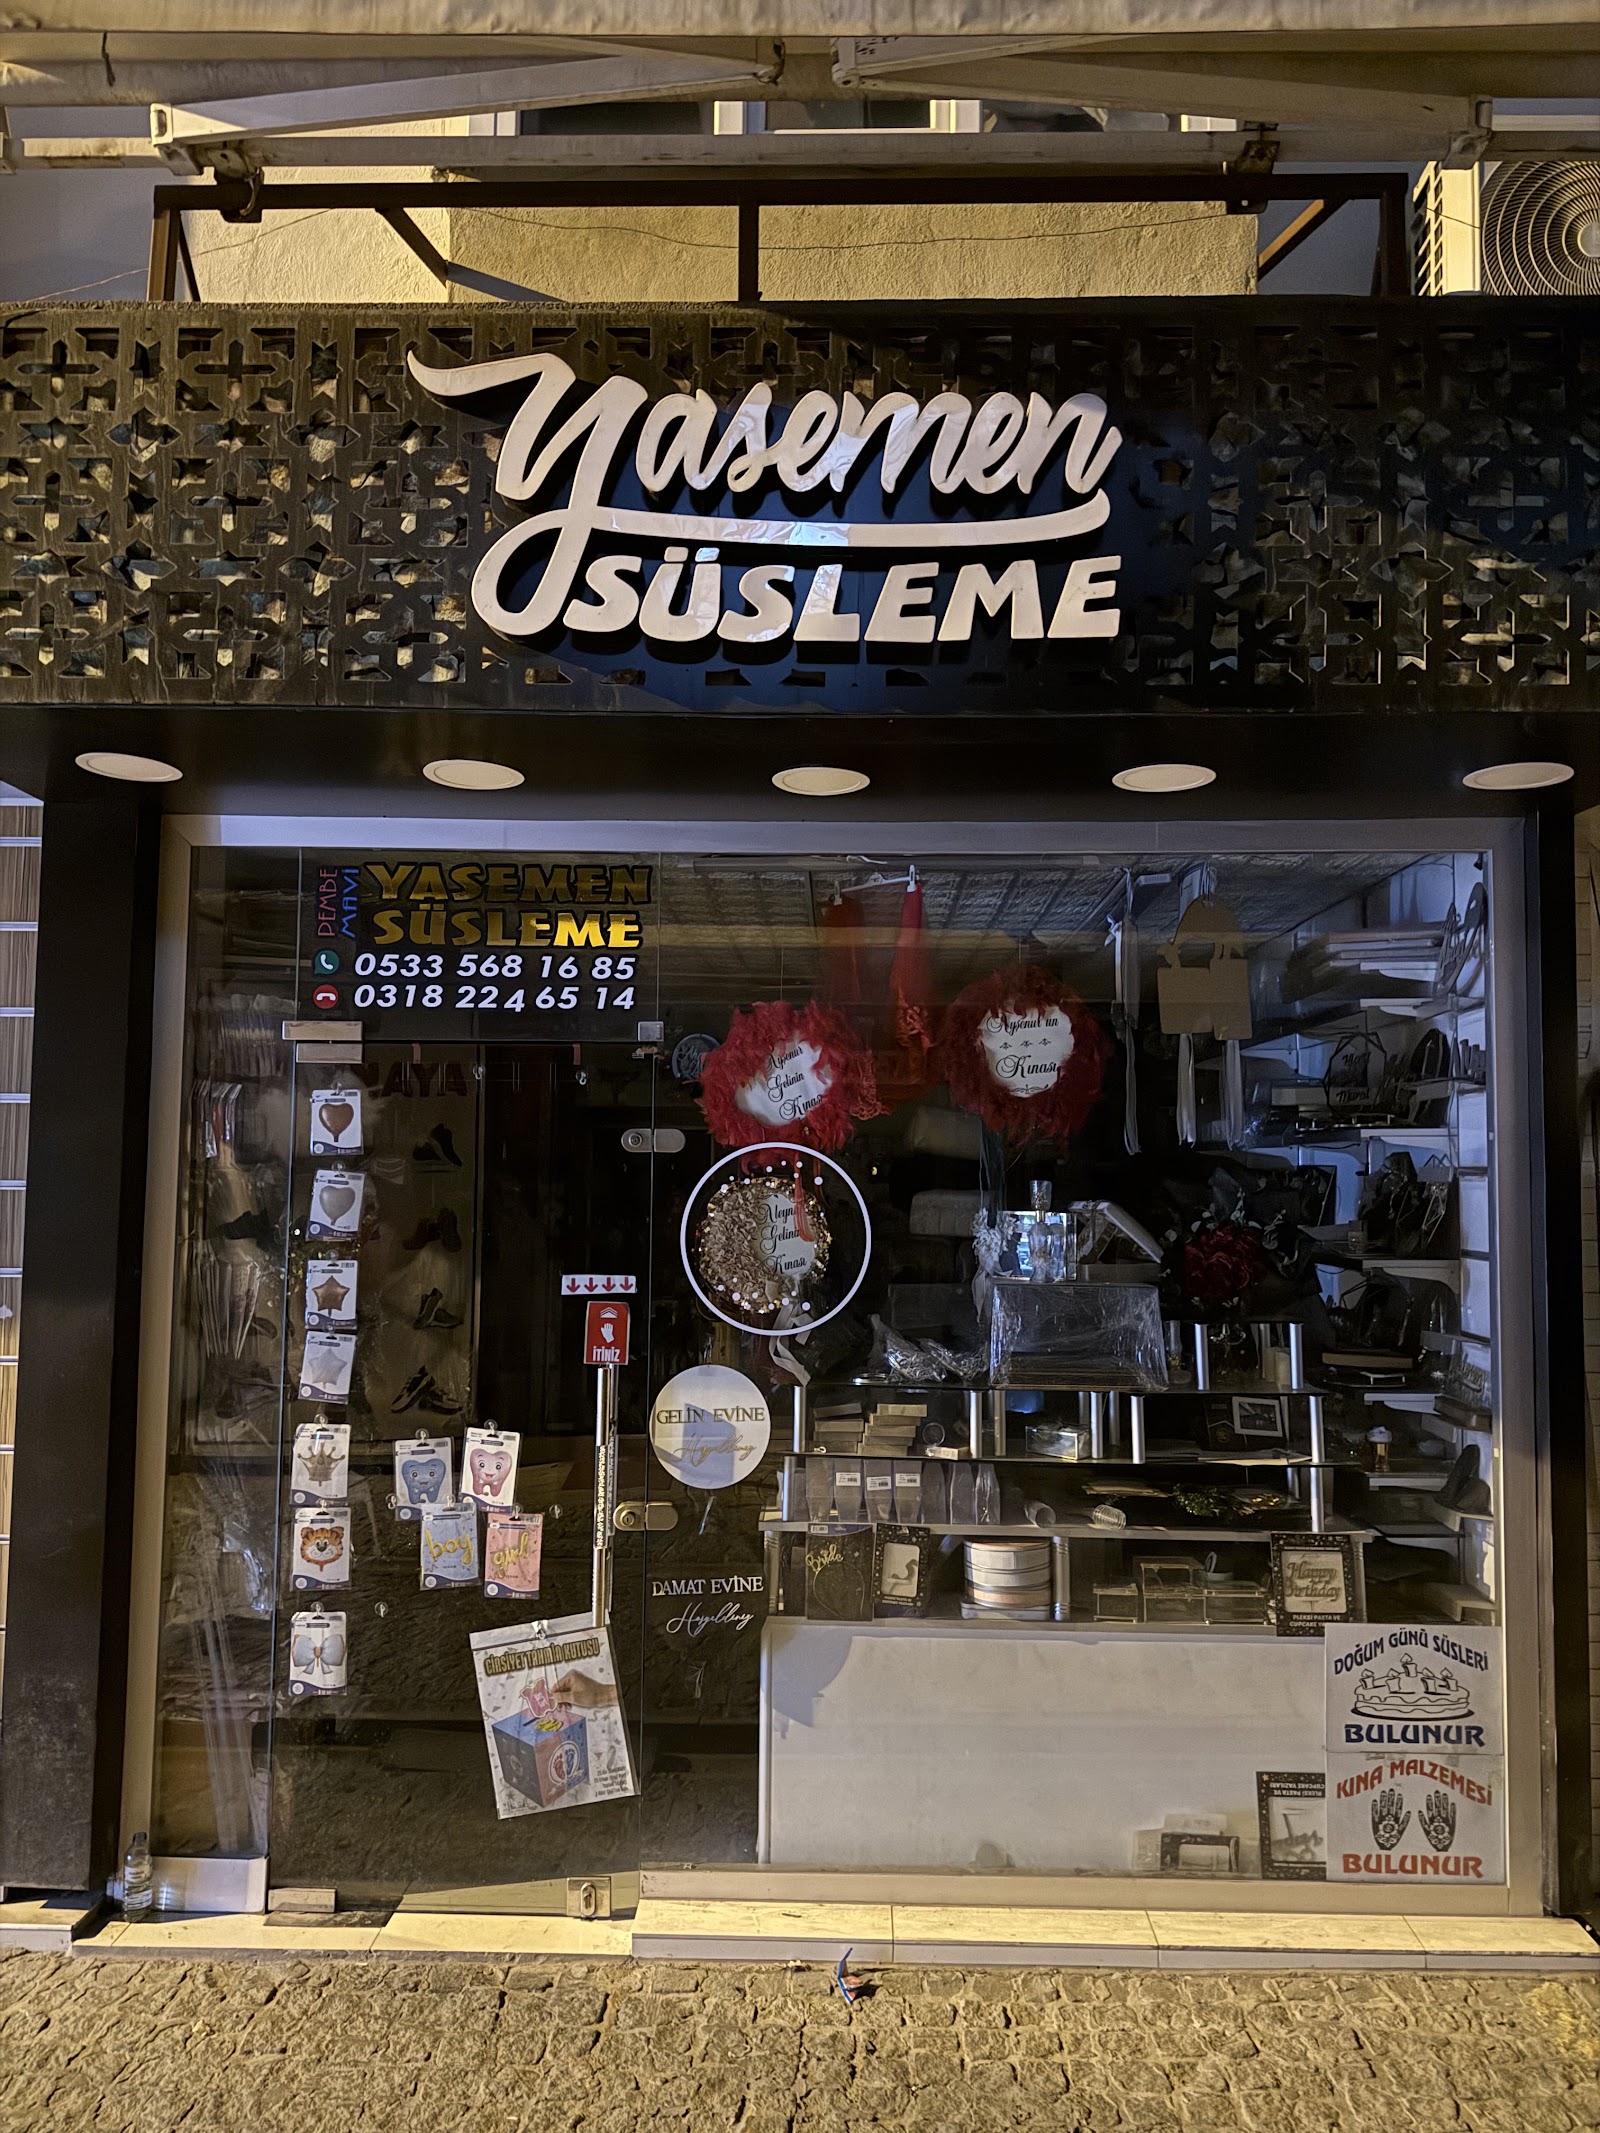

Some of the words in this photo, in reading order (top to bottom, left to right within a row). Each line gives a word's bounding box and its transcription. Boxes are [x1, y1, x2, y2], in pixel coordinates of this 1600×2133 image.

[406, 350, 1123, 636] Yasemen
[563, 547, 1122, 642] SÜSLEME
[364, 861, 652, 904] YASEMEN
[317, 868, 338, 938] PEMBE
[372, 902, 641, 948] SÜSLEME
[354, 954, 444, 978] 0533
[456, 954, 523, 978] 568
[540, 955, 578, 979] 16
[591, 956, 636, 980] 85
[354, 984, 443, 1009] 0318
[455, 985, 525, 1013] 224
[535, 986, 580, 1010] 65
[596, 987, 635, 1010] 14
[766, 1072, 805, 1103] Gelinin
[592, 1345, 621, 1362] İTİNİZ
[657, 1407, 705, 1425] GELİN
[713, 1405, 765, 1423] EVİNE
[425, 1527, 474, 1566] boy
[493, 1531, 529, 1579] girl
[652, 1578, 706, 1597] DAMAT
[711, 1574, 764, 1595] EVİNE
[1287, 1560, 1338, 1583] Happy
[563, 1637, 601, 1661] KUTUSU
[1334, 1642, 1385, 1675] DOĞUM
[1388, 1626, 1429, 1649] GÜNÜ
[1432, 1634, 1489, 1672] SÜSLERİ
[1344, 1723, 1486, 1747] BULUNUR
[1336, 1764, 1384, 1800] KINA
[1389, 1758, 1493, 1807] MALZEMESİ
[1342, 1852, 1484, 1878] BULUNUR
